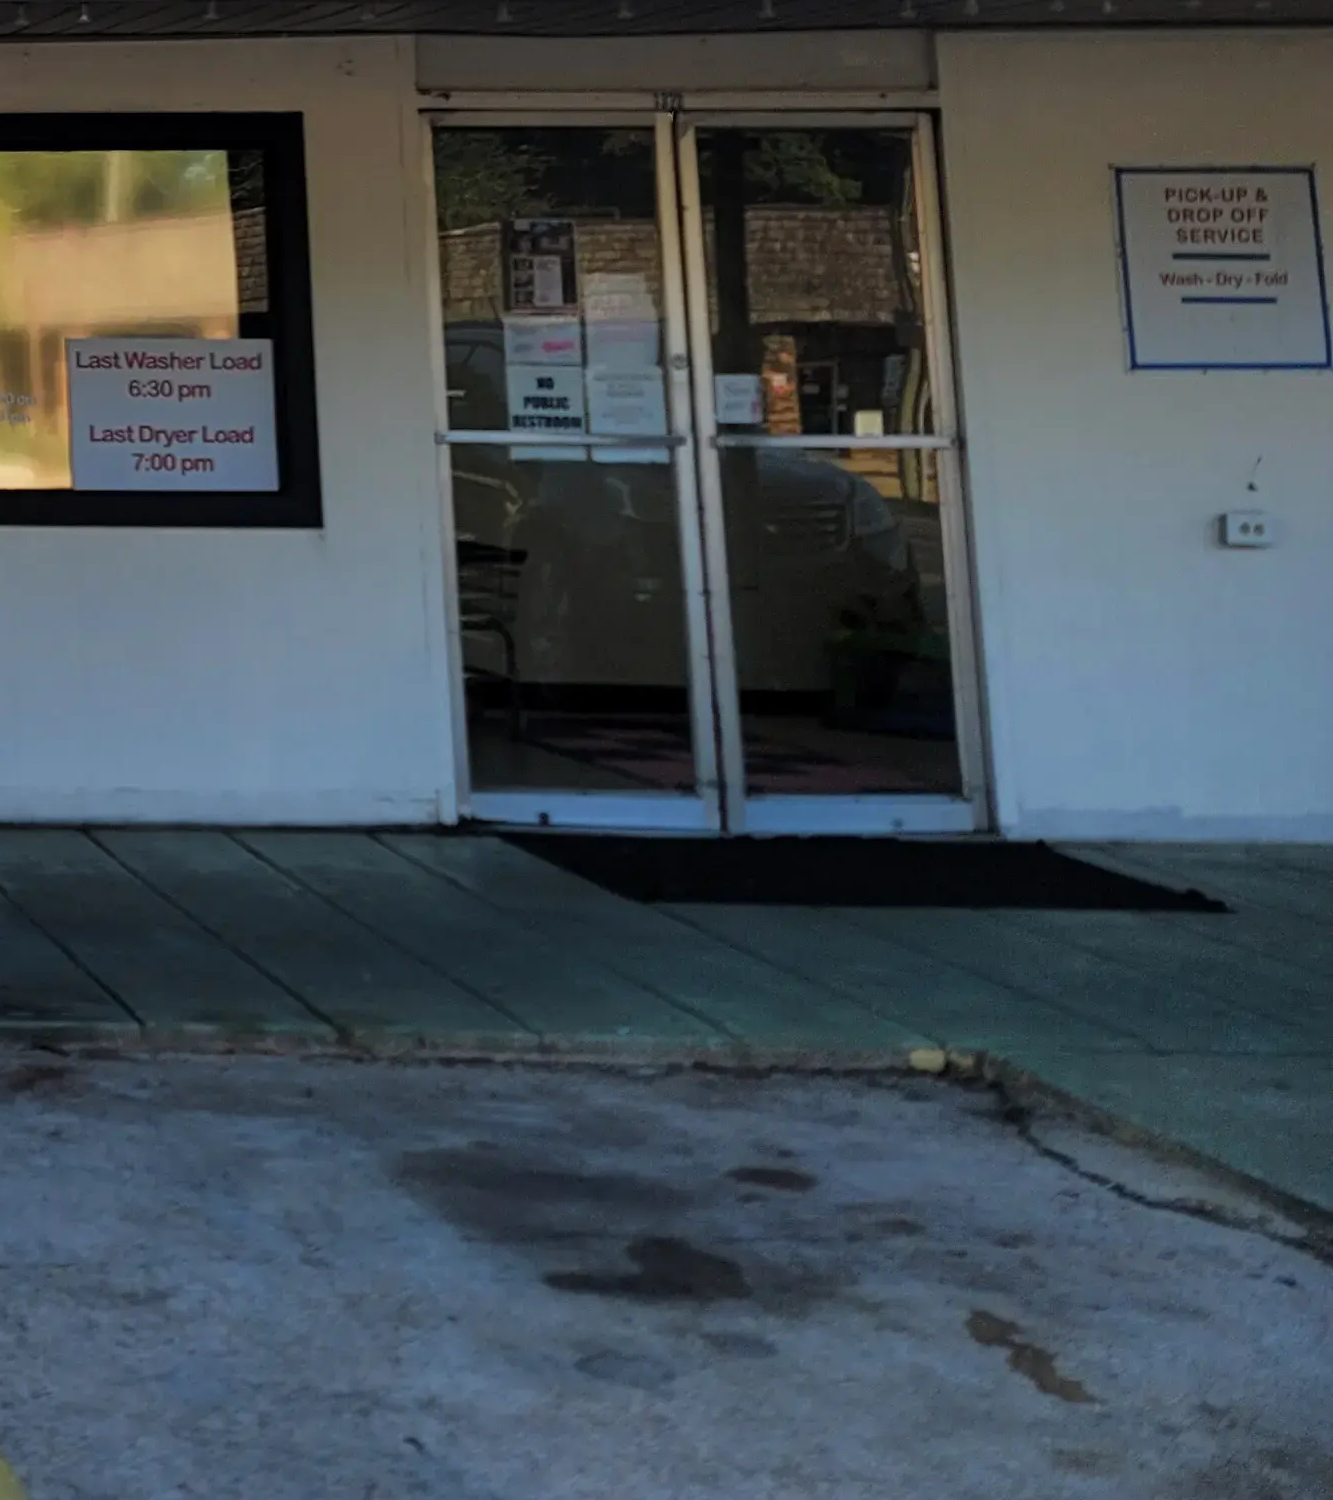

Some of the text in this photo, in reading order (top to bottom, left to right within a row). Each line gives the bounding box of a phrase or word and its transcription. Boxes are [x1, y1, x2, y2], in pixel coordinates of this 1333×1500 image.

[1165, 187, 1269, 203] PICK-UP &
[1167, 207, 1270, 224] DROP OFF
[1176, 228, 1264, 244] SERVICE
[1159, 273, 1204, 287] Wash
[1215, 272, 1244, 289] Dry
[1255, 271, 1289, 286] Fold
[75, 351, 263, 371] Last Washer Load
[128, 379, 211, 402] 6:30 pm
[523, 396, 571, 411] PUBLIC
[89, 425, 255, 447] Last Dryer Load
[131, 453, 215, 475] 7:00 pm
